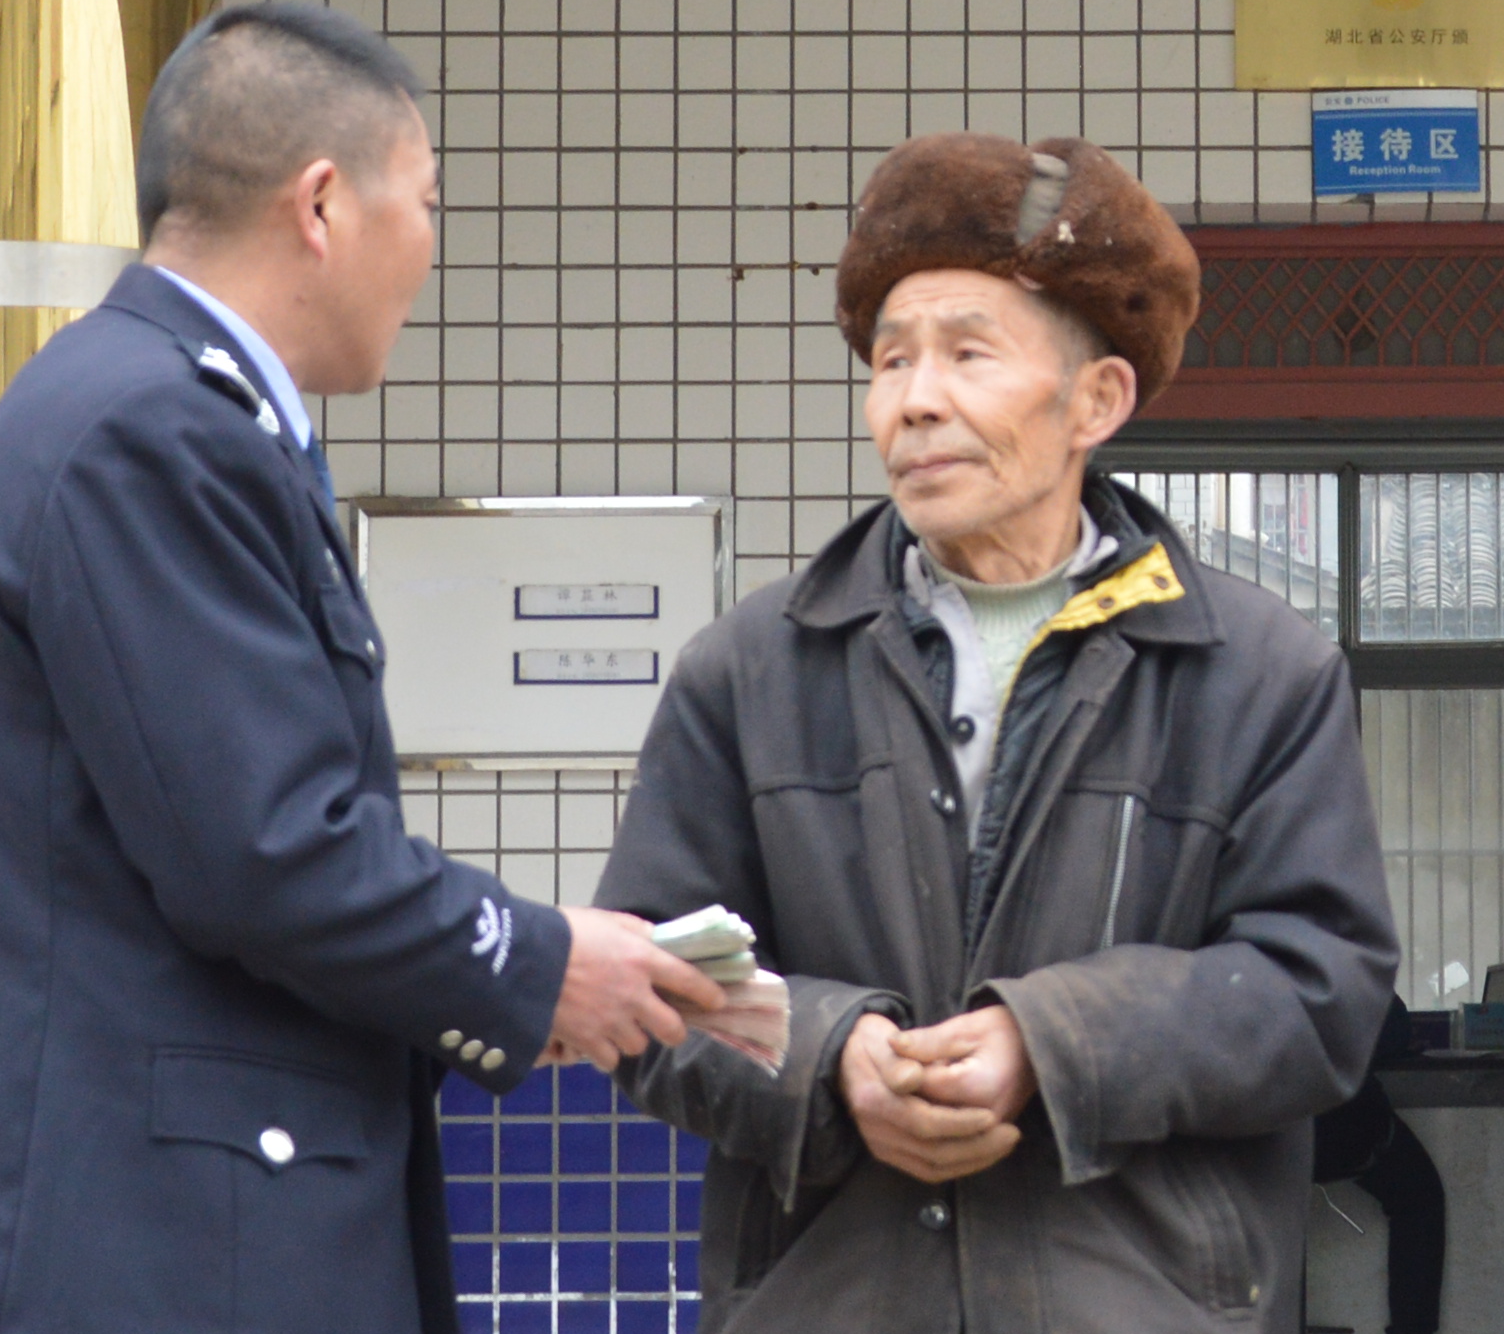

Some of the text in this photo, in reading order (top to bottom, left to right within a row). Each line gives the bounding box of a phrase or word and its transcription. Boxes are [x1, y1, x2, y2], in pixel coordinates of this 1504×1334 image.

[1325, 28, 1469, 45] 湖北省公安厅颁
[1356, 95, 1390, 105] POLICE
[1332, 127, 1459, 162] 接待区
[1349, 163, 1441, 177] Reception Room
